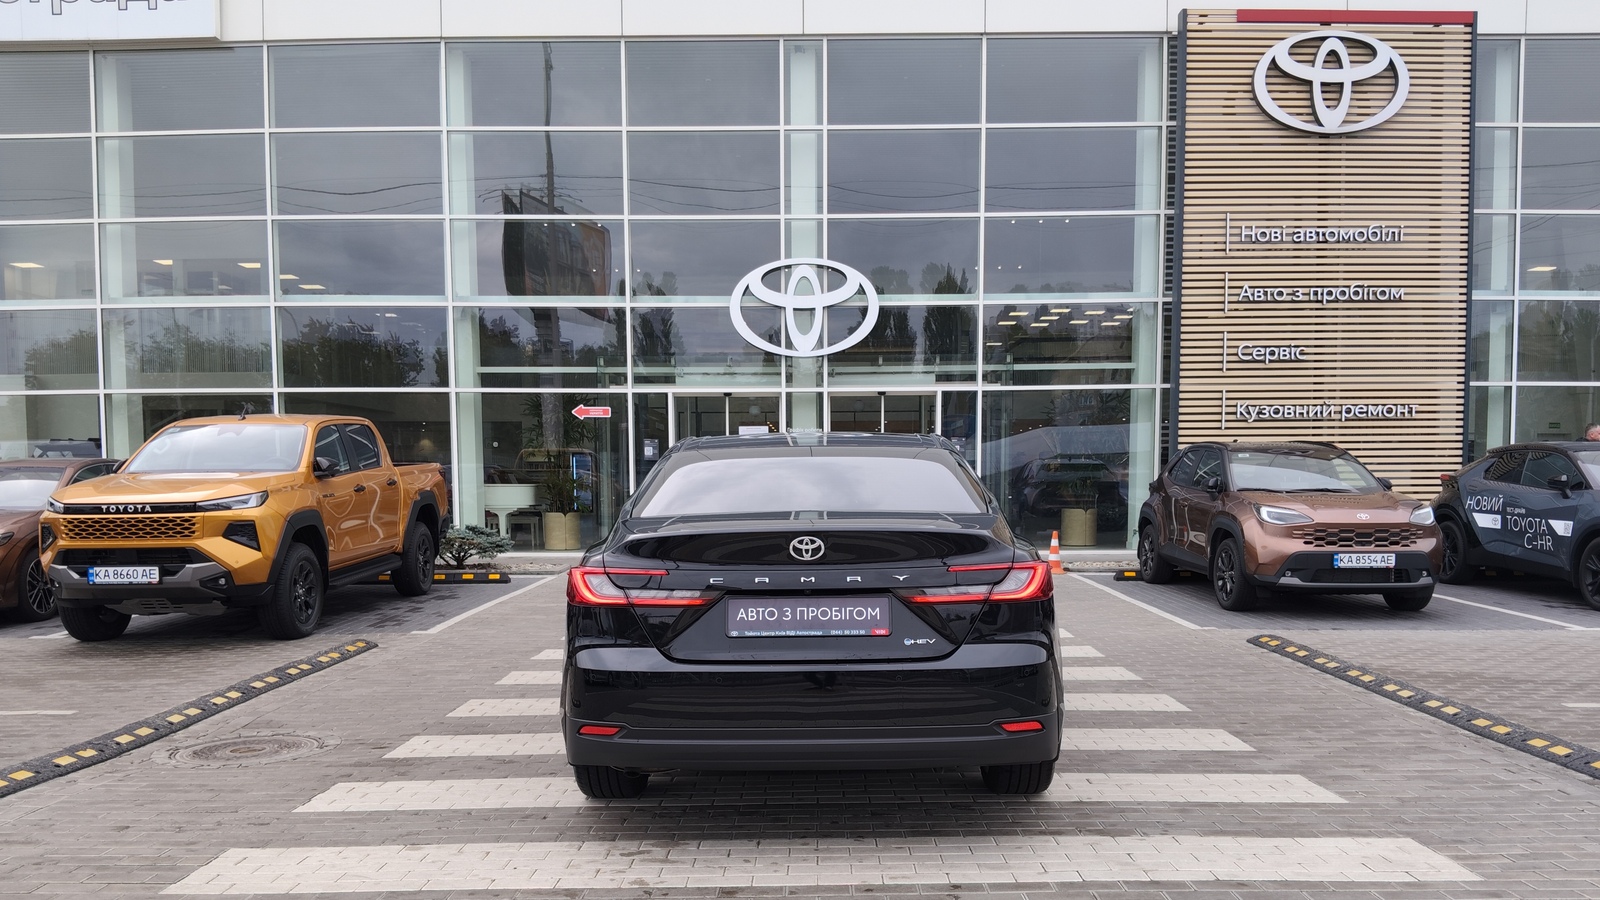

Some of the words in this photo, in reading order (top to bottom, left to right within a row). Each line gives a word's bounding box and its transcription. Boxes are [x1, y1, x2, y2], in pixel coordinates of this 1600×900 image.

[1240, 224, 1287, 242] Нові
[1292, 223, 1405, 242] автомобілі
[1238, 284, 1287, 301] Авто
[1291, 287, 1303, 301] з
[1309, 282, 1405, 305] пробігом
[1237, 343, 1307, 365] Сервіс
[1235, 400, 1335, 423] Кузовний
[1340, 403, 1419, 422] ремонт
[101, 505, 152, 513] TOYOTA
[1465, 494, 1504, 512] НОВИЙ
[1506, 515, 1548, 534] TOYOTA
[1524, 533, 1554, 551] C-HR
[1339, 555, 1353, 565] KA
[1355, 555, 1378, 565] 8554
[1380, 555, 1394, 565] AE
[94, 569, 111, 580] KA
[112, 569, 139, 580] 8660
[140, 569, 157, 580] AE
[709, 574, 910, 584] CAMRY
[736, 607, 778, 621] АВТО
[782, 607, 792, 621] З
[796, 607, 880, 621] ПРОБІГОМ
